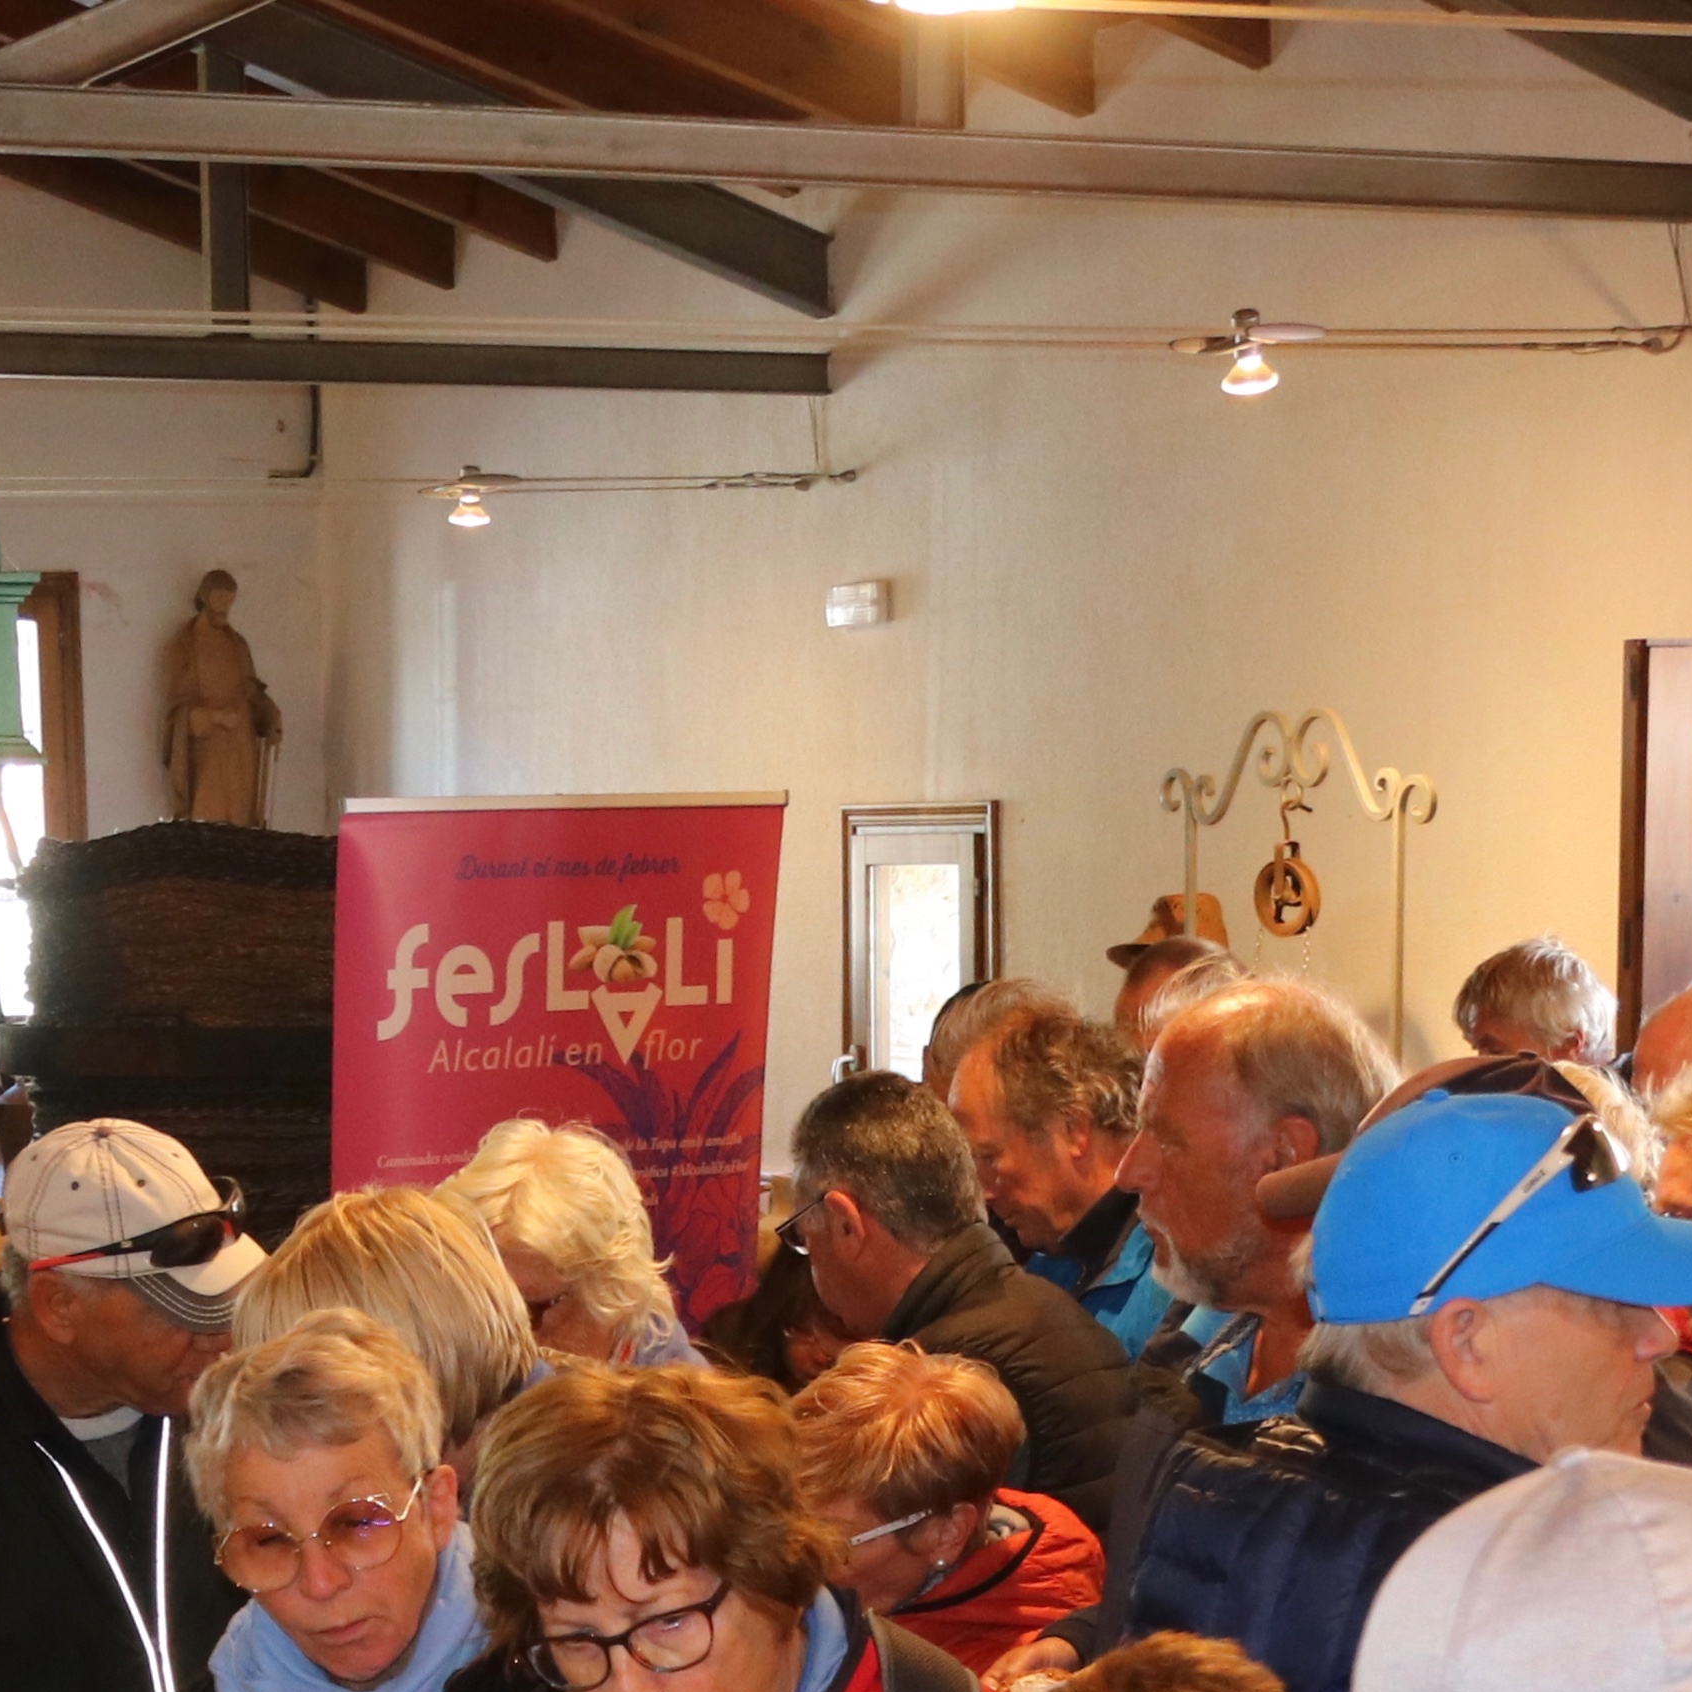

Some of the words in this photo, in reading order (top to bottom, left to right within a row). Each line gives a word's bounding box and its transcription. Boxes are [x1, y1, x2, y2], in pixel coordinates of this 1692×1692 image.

[457, 854, 526, 881] Durant
[533, 857, 550, 877] el
[556, 860, 590, 877] mes
[594, 856, 617, 876] de
[618, 852, 679, 885] febrer
[428, 1034, 557, 1074] Alcalalí
[565, 1040, 604, 1067] en
[642, 1028, 702, 1069] flor
